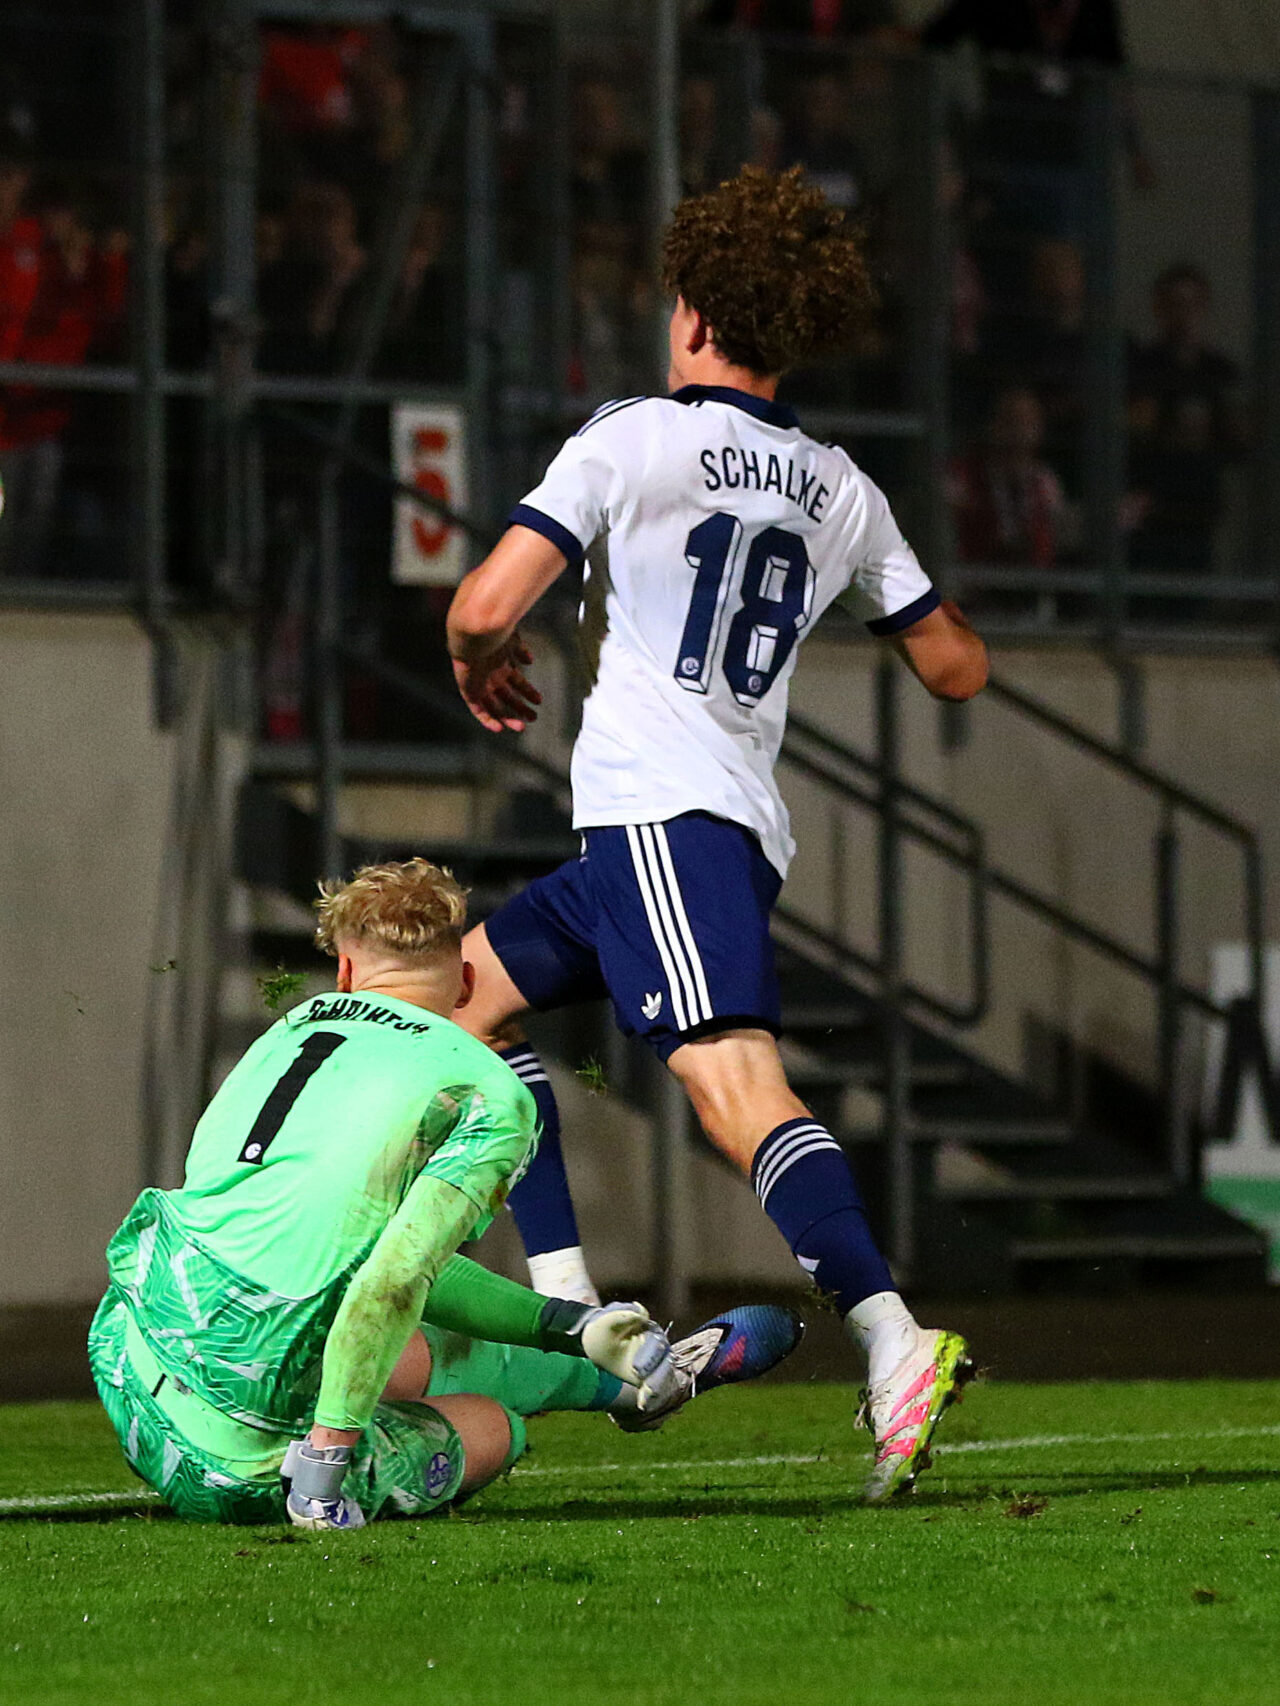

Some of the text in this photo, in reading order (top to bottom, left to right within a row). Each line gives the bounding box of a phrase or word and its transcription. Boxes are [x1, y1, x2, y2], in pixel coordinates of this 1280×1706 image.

[700, 446, 829, 524] SCHALKE
[674, 511, 816, 708] 18
[237, 1031, 348, 1165] 1
